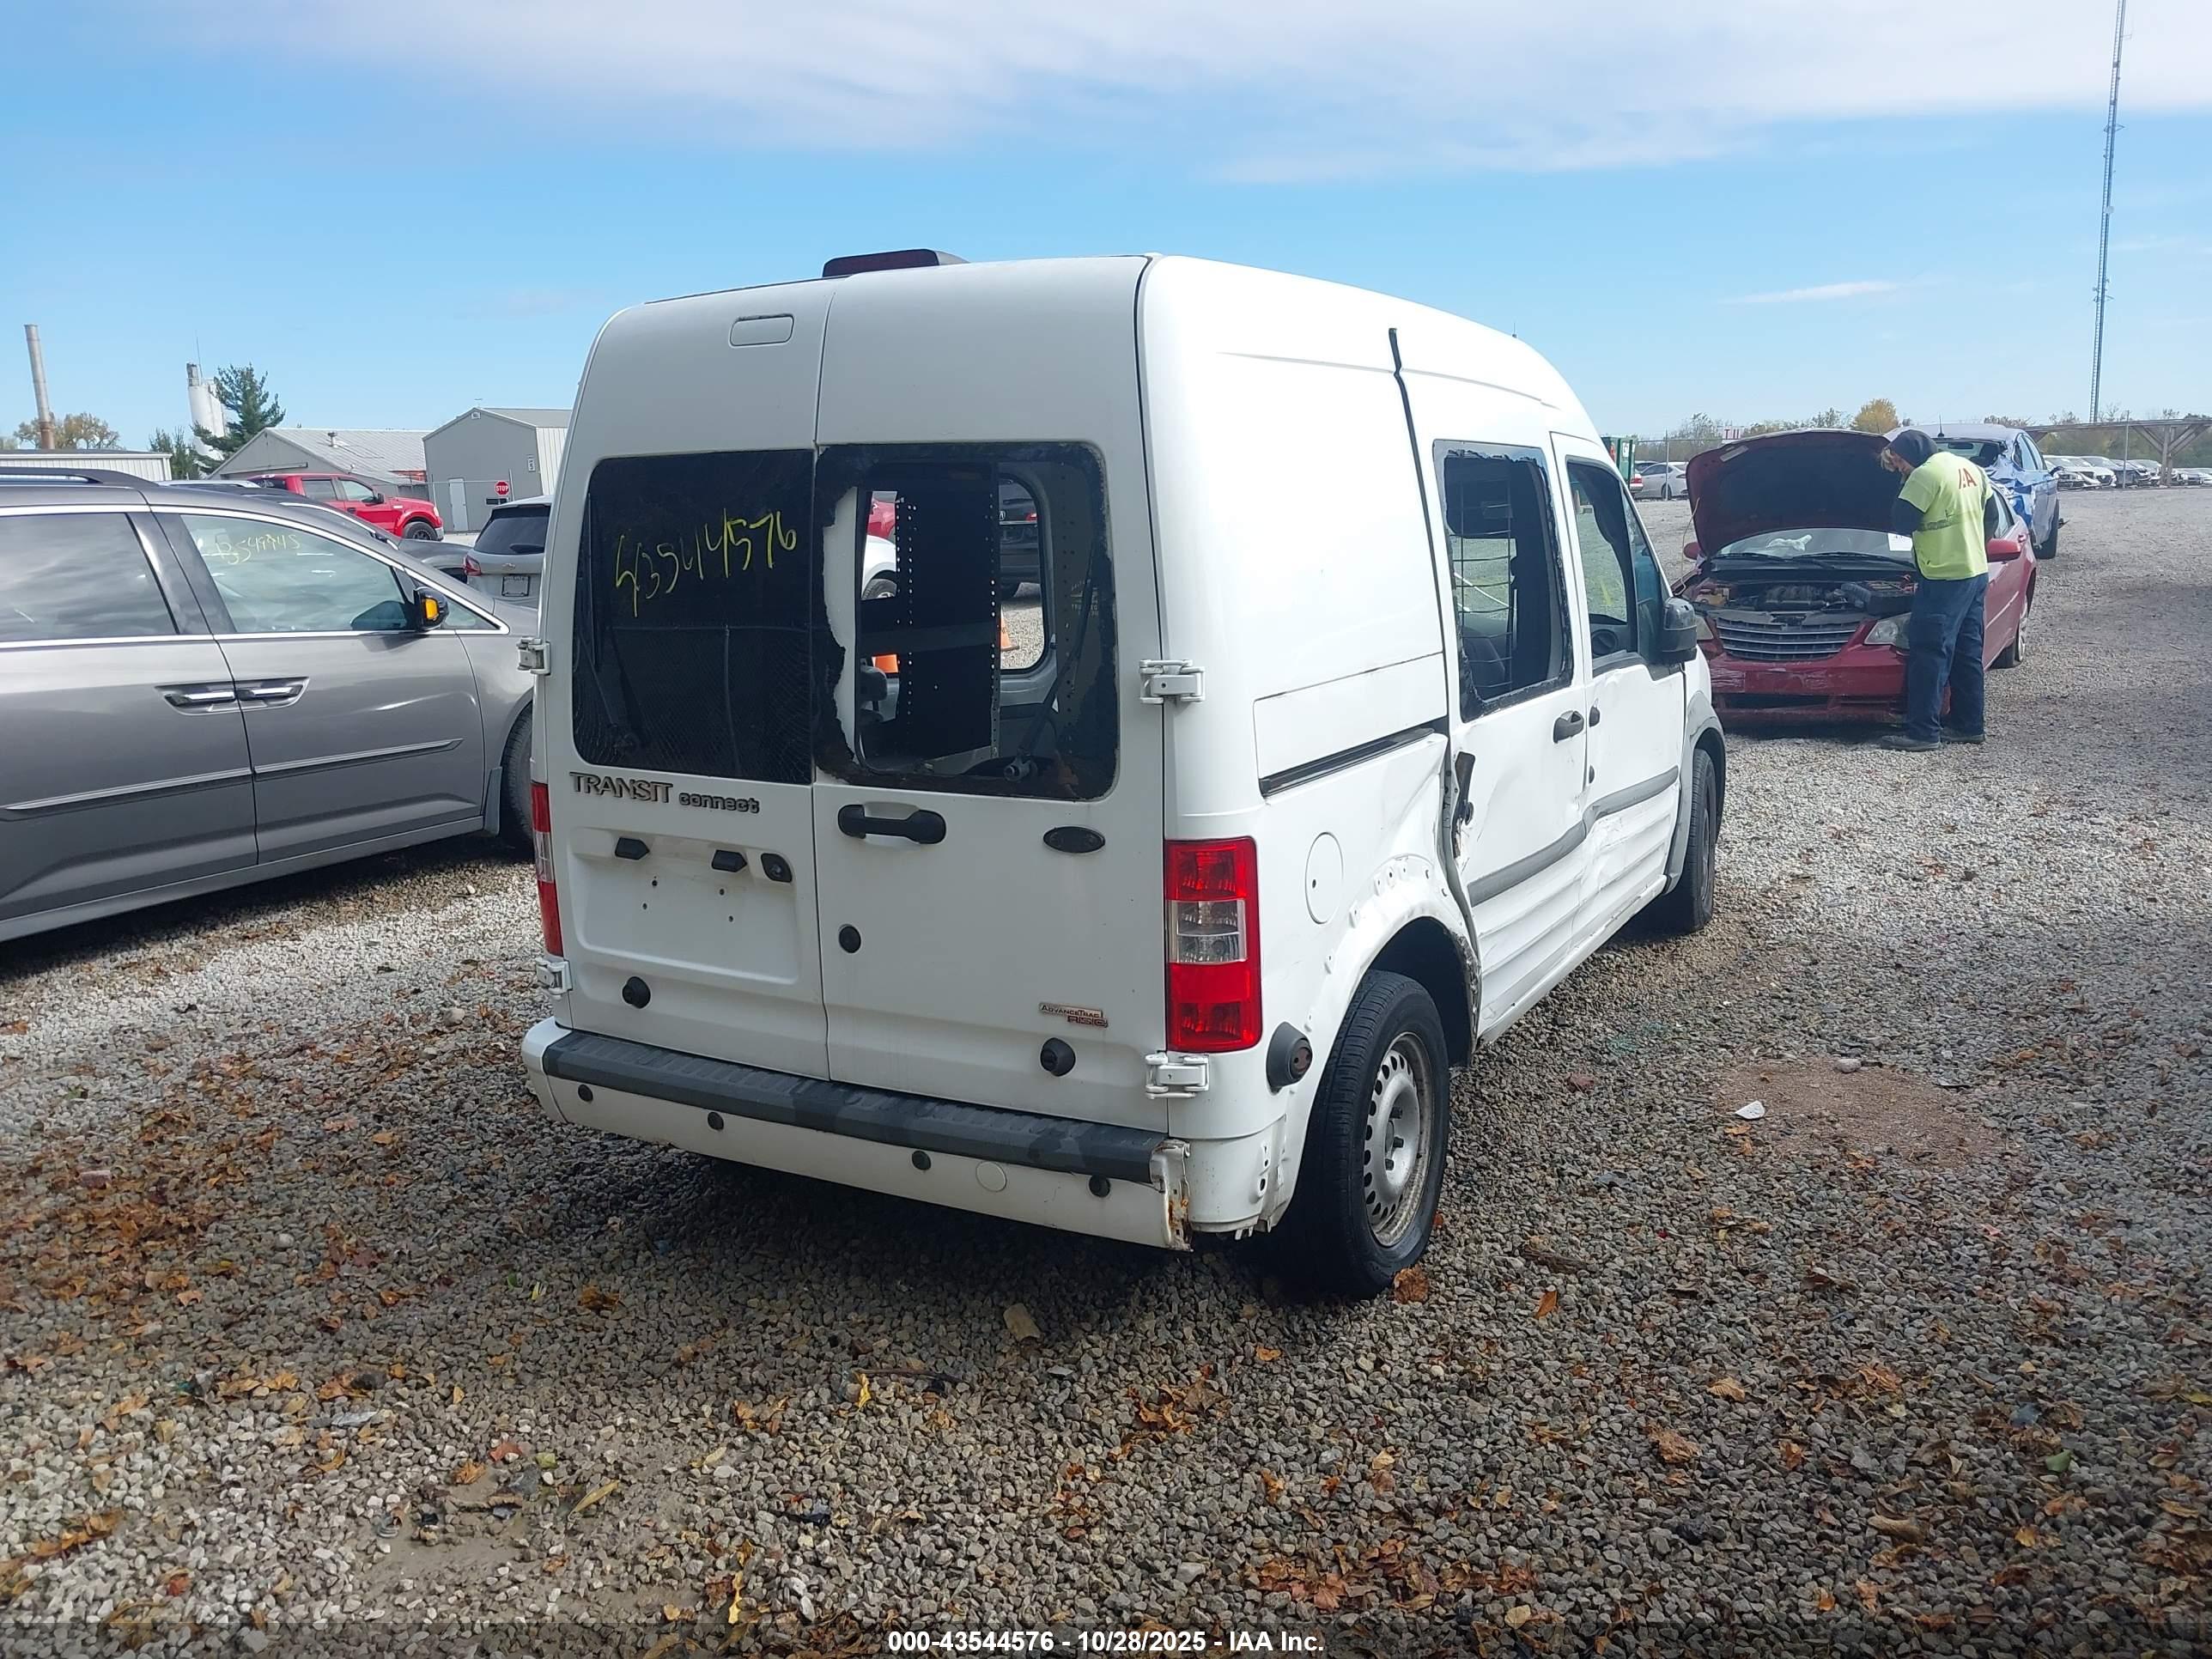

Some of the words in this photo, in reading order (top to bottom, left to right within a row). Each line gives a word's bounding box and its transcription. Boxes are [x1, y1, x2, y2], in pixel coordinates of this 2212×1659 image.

[616, 507, 797, 617] 43544576
[569, 772, 673, 803] TRANSIT
[678, 792, 760, 813] connect
